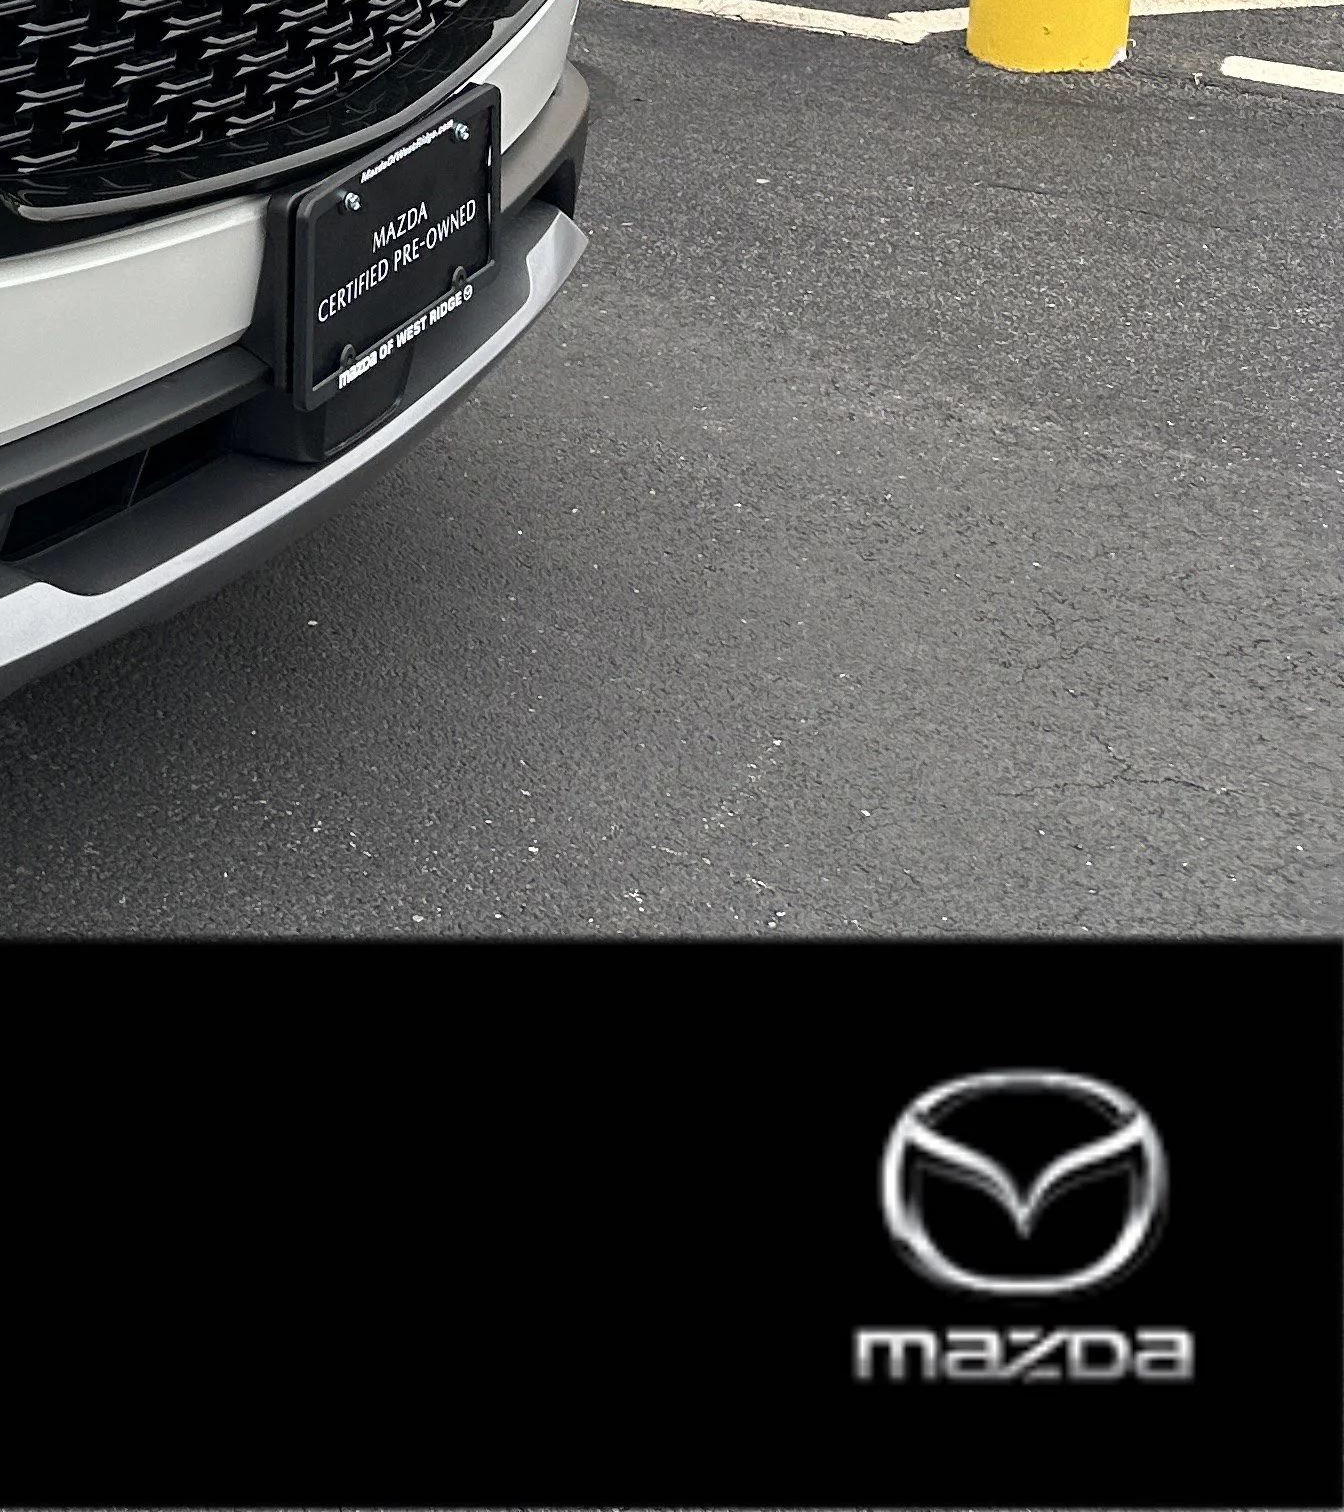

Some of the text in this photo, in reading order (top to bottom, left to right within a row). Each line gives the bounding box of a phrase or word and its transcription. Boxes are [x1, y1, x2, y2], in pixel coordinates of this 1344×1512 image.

[317, 199, 476, 323] CERTIFIED PRE-OWNED
[372, 201, 428, 253] MAZDA
[379, 338, 394, 360] OF
[396, 315, 428, 348] WEST
[429, 290, 463, 326] RIDGE
